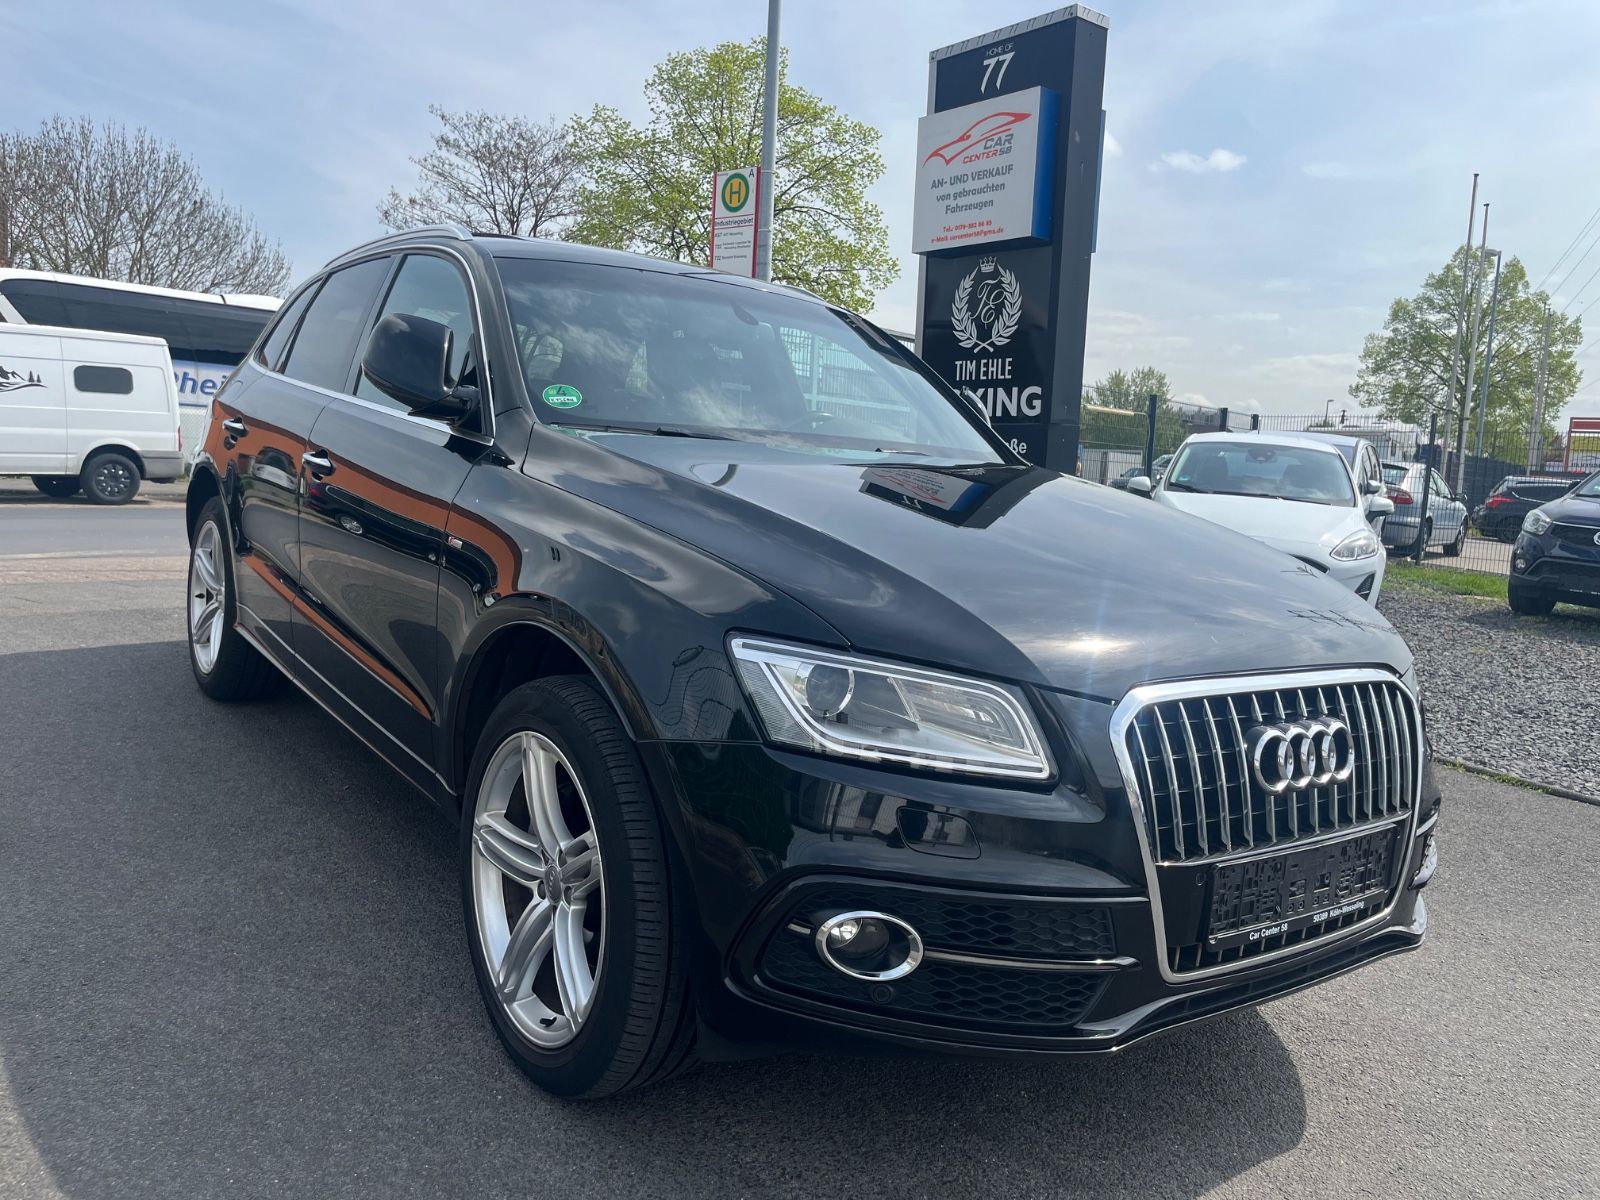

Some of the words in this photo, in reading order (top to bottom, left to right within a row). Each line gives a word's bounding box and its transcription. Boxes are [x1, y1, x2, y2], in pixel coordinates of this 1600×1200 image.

[986, 45, 1004, 56] HOME
[1004, 42, 1014, 51] OF
[980, 51, 1015, 94] 77
[983, 133, 1014, 150] CAR
[748, 168, 755, 178] A
[930, 178, 948, 190] AN-
[949, 173, 969, 186] UND
[971, 164, 1014, 182] VERKAUF
[936, 193, 951, 202] von
[952, 183, 1006, 200] gebrauchten
[945, 199, 994, 215] Fahrzeugen
[955, 359, 975, 381] TIM
[980, 357, 1013, 380] EHLE
[1249, 931, 1260, 940] Car
[1261, 926, 1280, 937] Center
